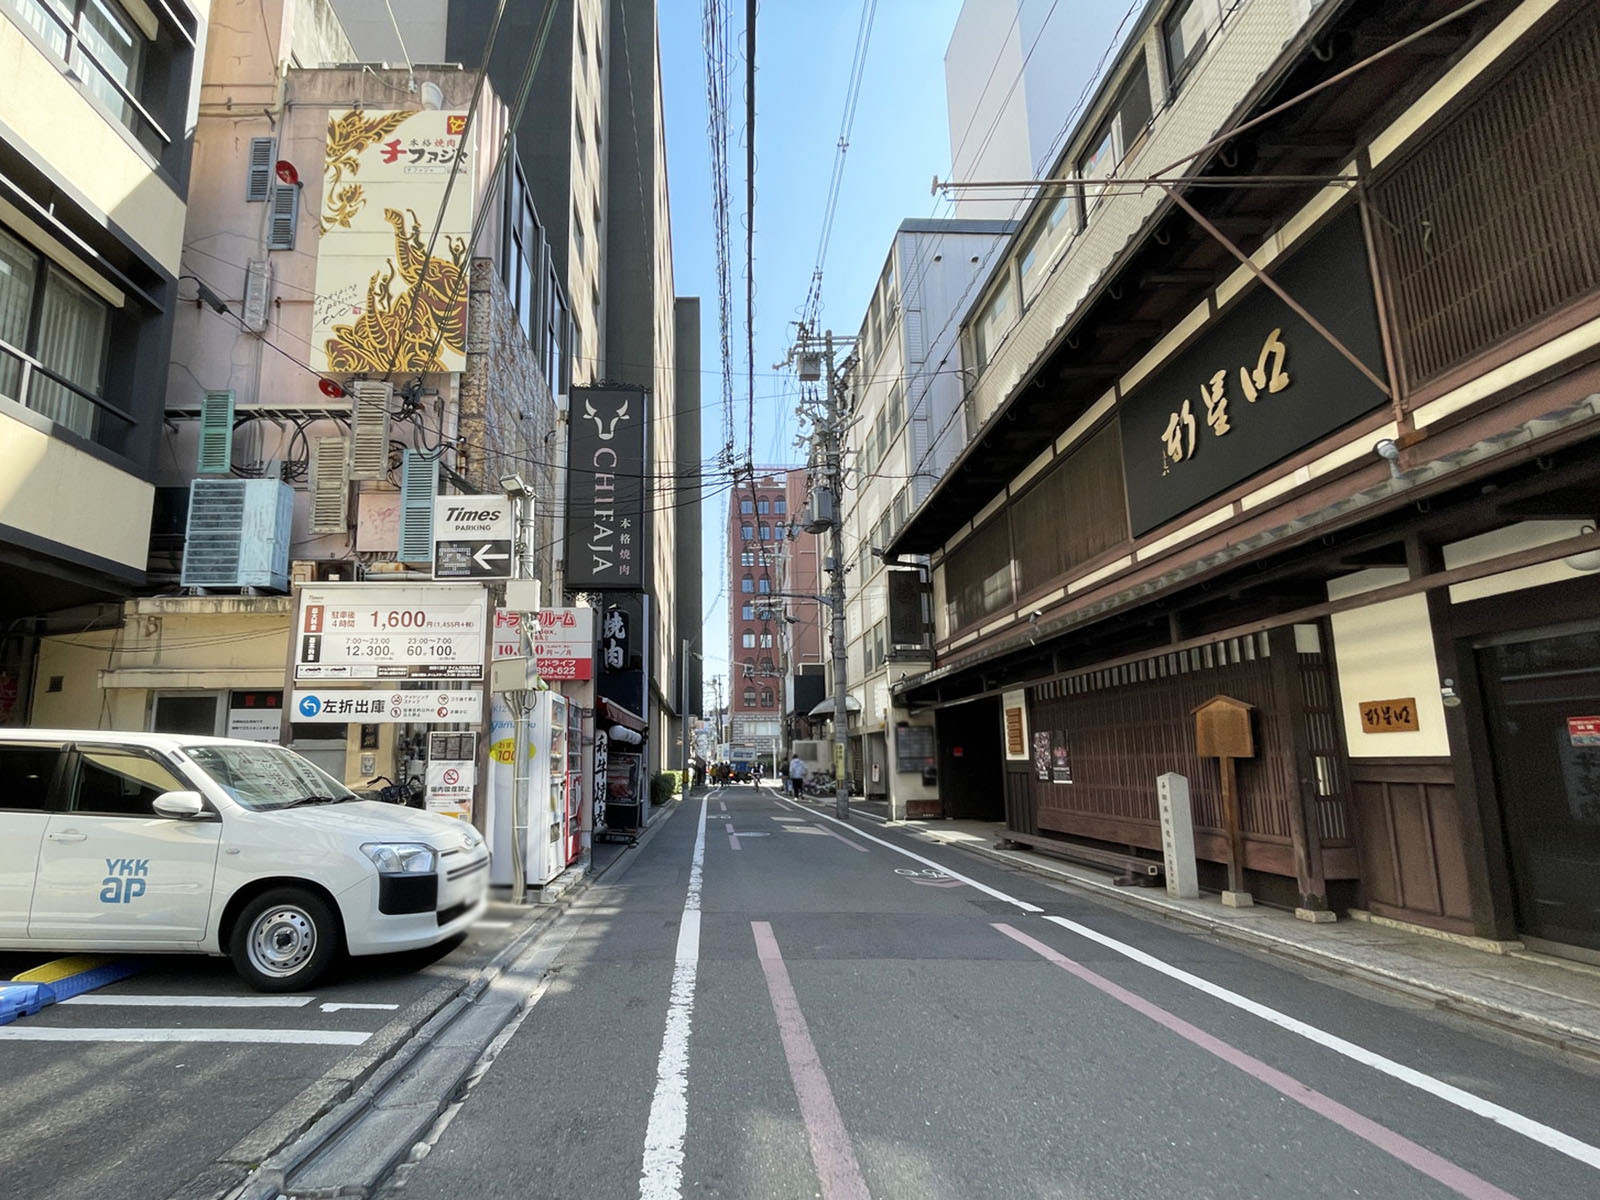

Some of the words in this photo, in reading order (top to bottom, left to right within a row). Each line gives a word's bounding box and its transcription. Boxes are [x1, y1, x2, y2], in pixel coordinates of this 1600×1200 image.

[410, 138, 456, 147] 本格焼肉
[446, 507, 502, 522] Times
[588, 447, 617, 576] CHIFAJA
[619, 517, 631, 576] 本格焼肉
[370, 610, 426, 631] 1,600
[603, 611, 626, 669] 焼肉
[322, 699, 386, 713] 左折出庫
[105, 858, 149, 877] YKK
[99, 877, 147, 904] ap
